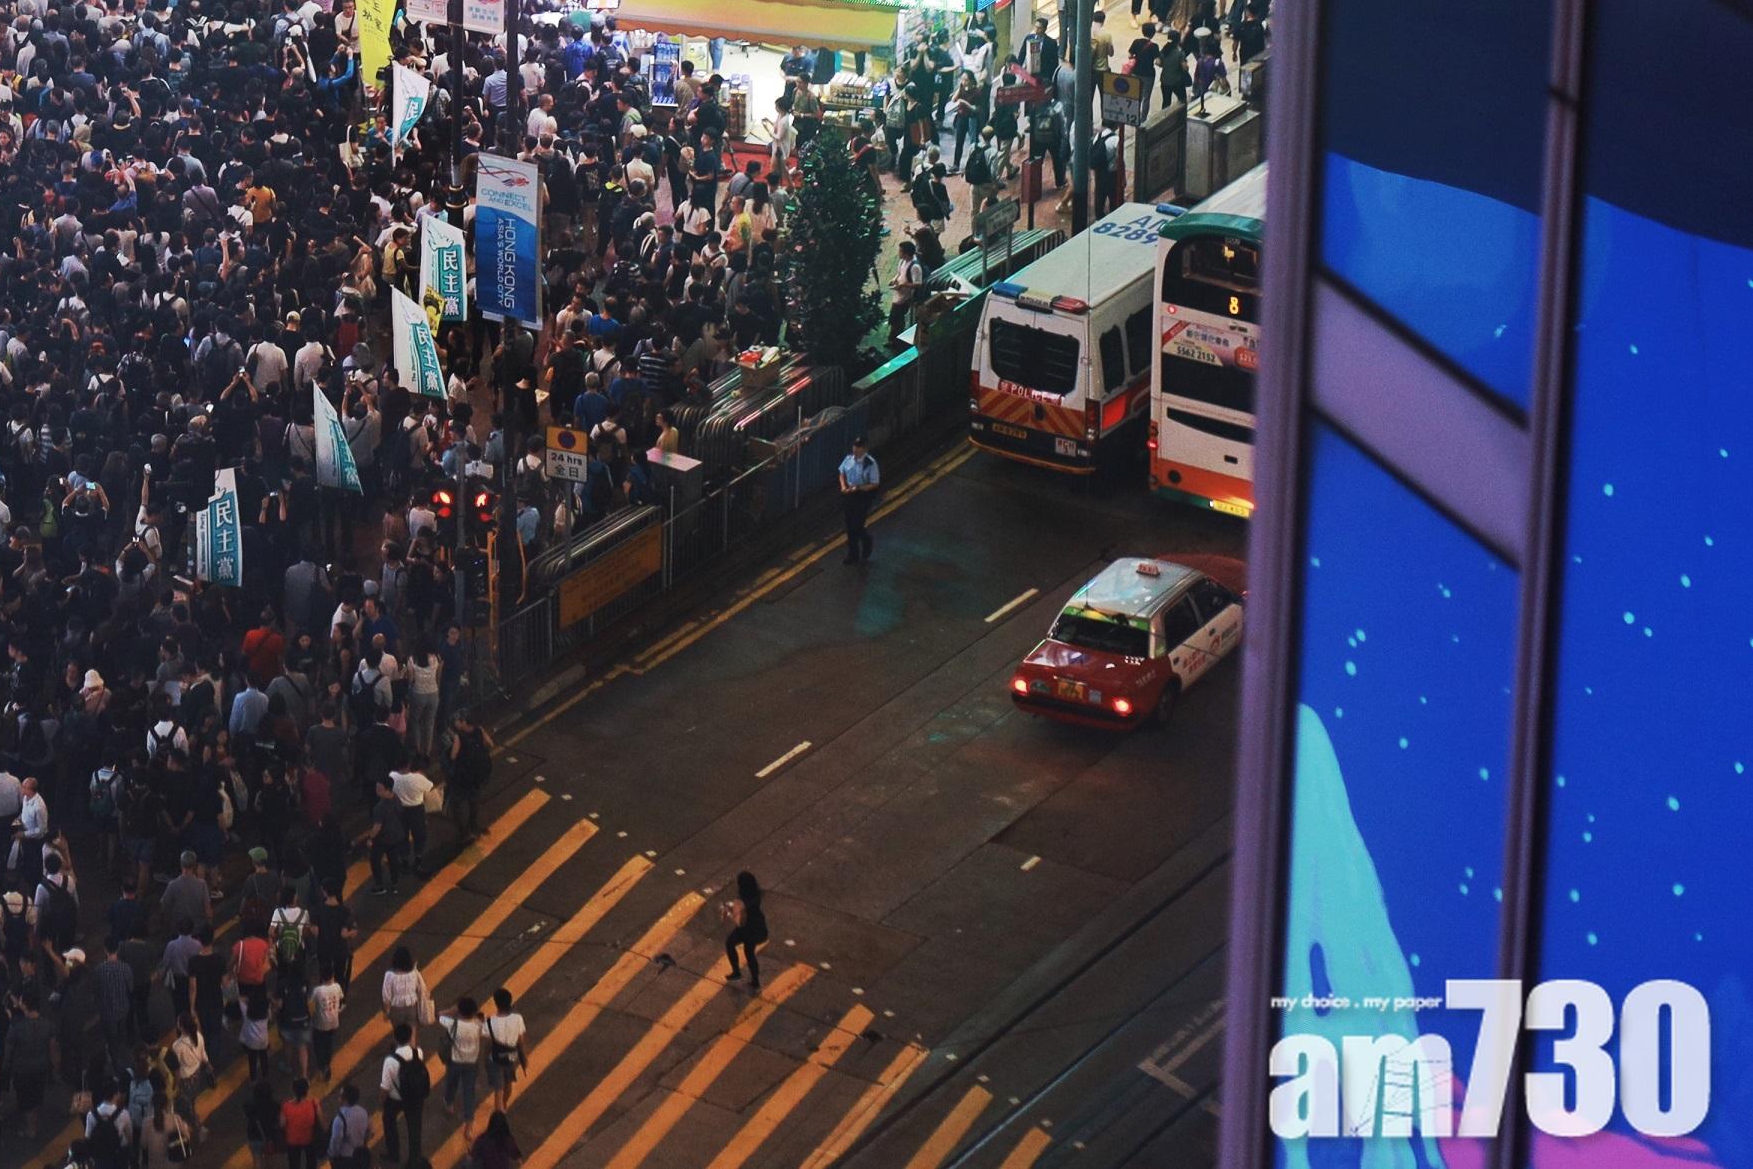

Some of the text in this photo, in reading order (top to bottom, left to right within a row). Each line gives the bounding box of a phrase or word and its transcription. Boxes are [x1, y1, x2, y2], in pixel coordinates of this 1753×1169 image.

[481, 187, 527, 203] CONNECT
[489, 197, 534, 213] AND EXCEL
[1093, 222, 1159, 245] 8289
[497, 217, 505, 306] ASIA'S WORLD CITY
[503, 217, 517, 310] HONG KONG
[442, 250, 460, 316] 民主黨
[1229, 296, 1239, 315] 8
[417, 323, 441, 393] 民主黨
[1177, 345, 1195, 359] 5562
[1010, 385, 1048, 402] POLICE
[550, 451, 583, 466] 24 hrs
[554, 464, 580, 479] 全日
[215, 499, 235, 580] 民主黨
